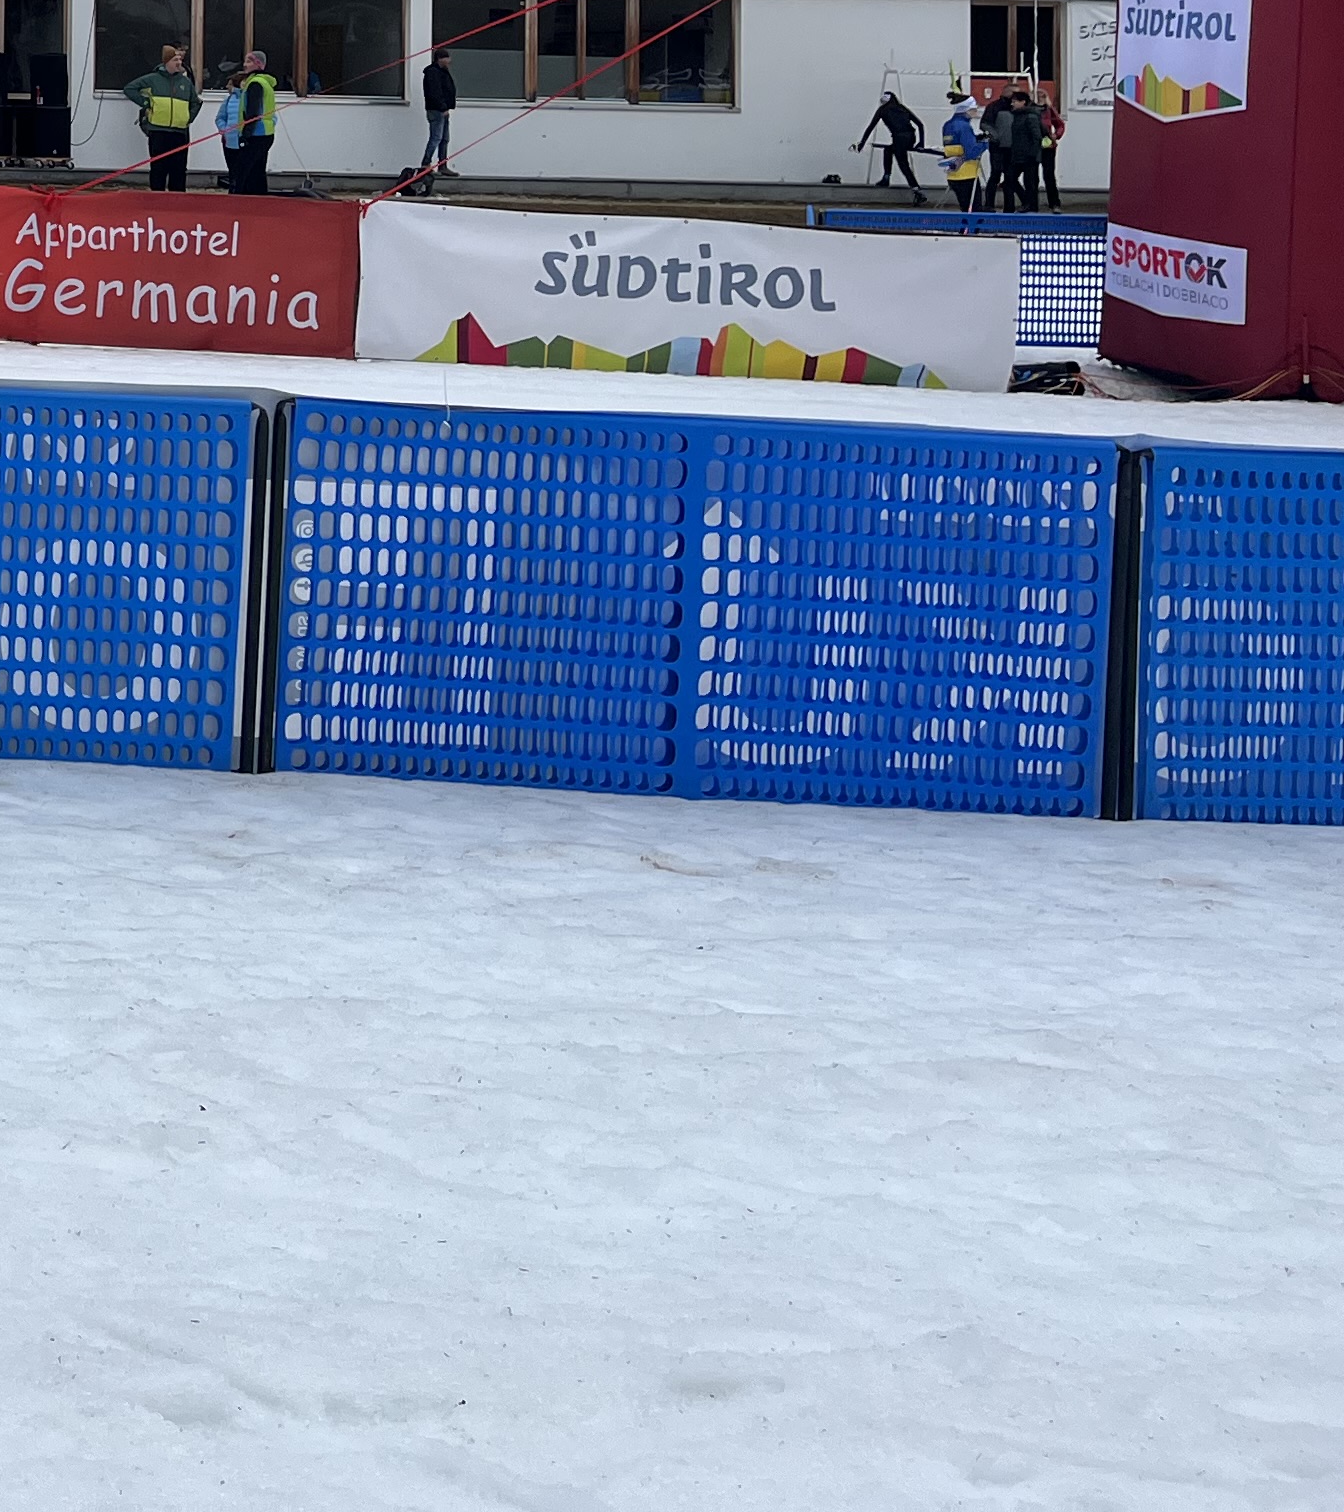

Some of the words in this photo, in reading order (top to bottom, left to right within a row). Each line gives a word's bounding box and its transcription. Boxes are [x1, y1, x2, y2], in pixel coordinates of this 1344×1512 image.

[15, 212, 239, 259] Apparthotel
[1112, 236, 1228, 289] SPORTOK
[4, 257, 319, 330] Germania
